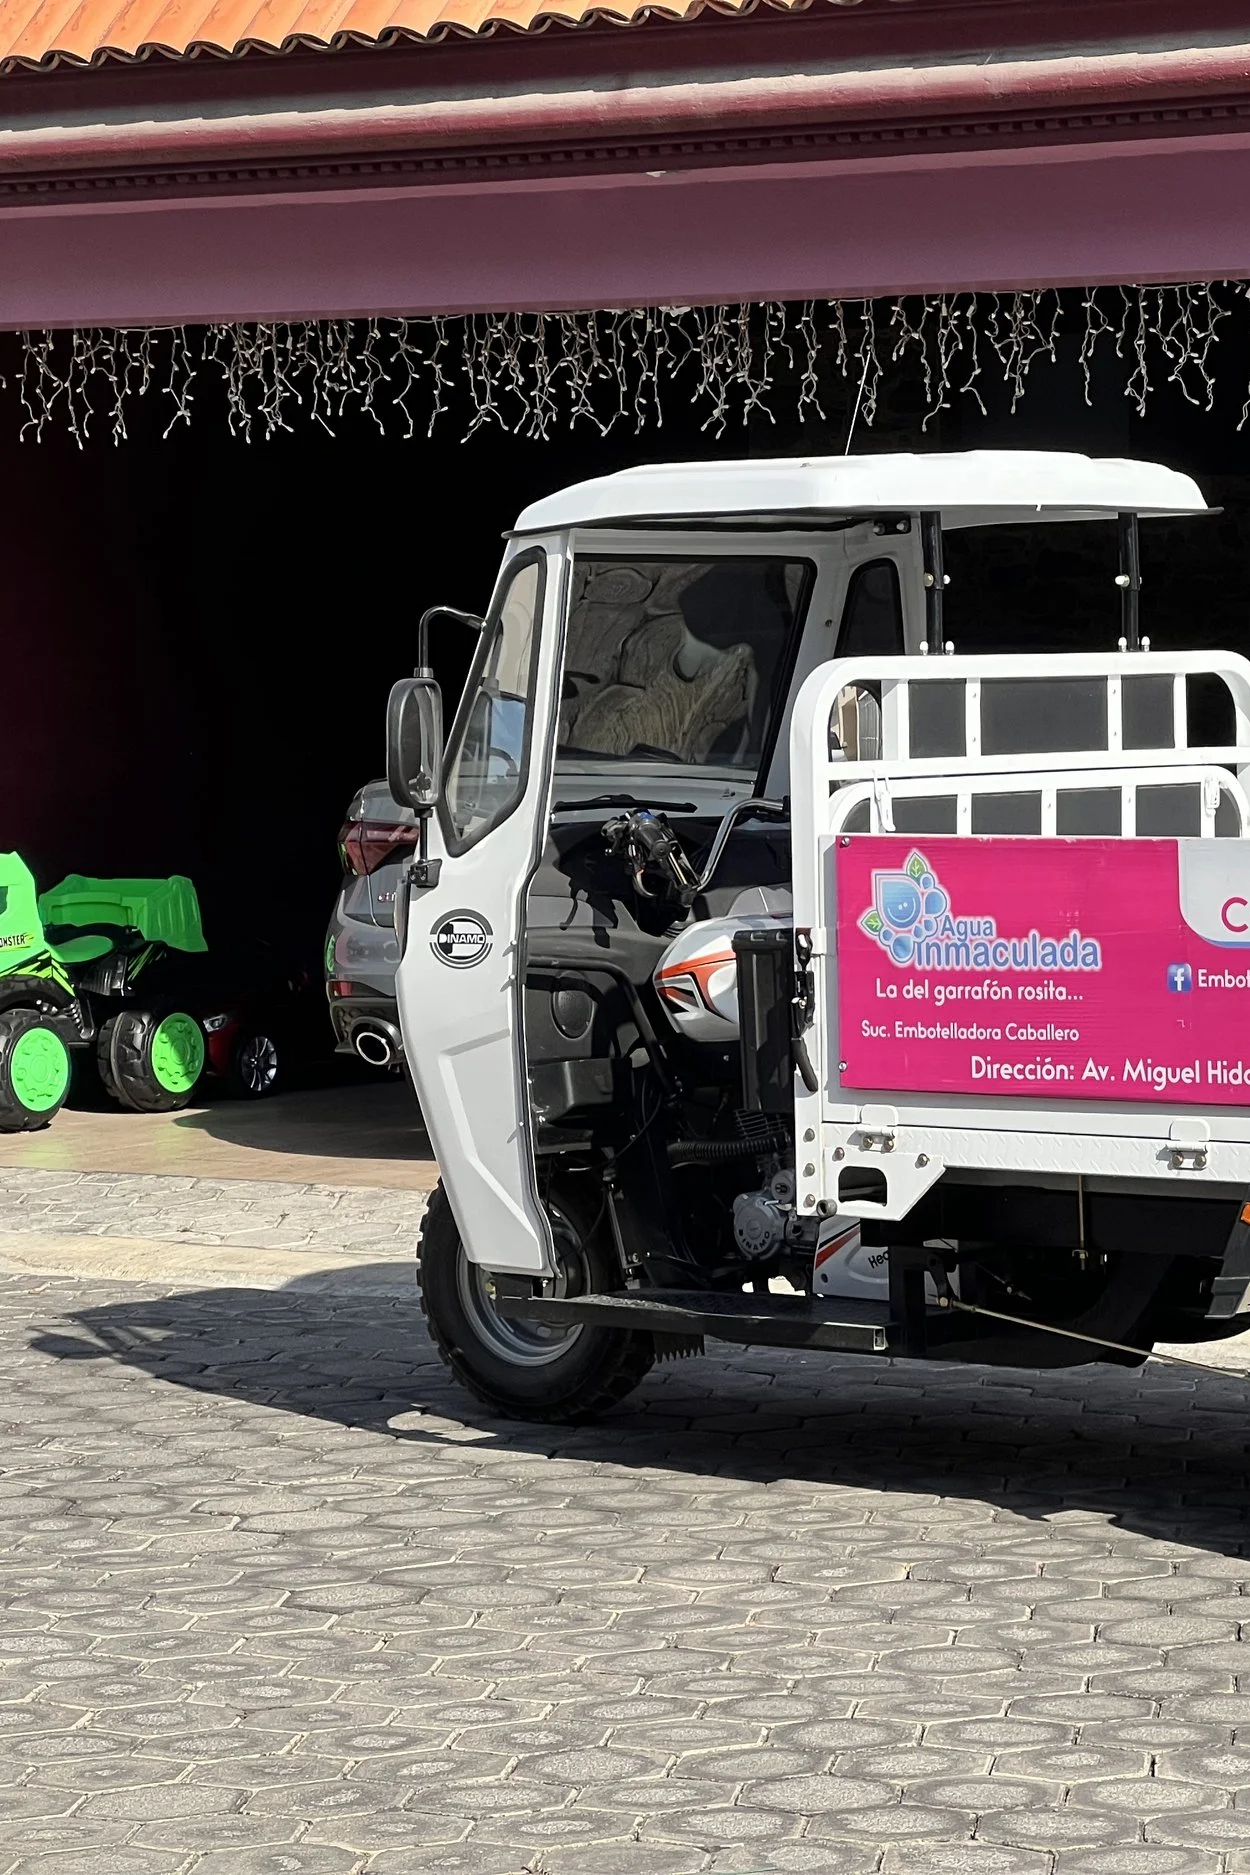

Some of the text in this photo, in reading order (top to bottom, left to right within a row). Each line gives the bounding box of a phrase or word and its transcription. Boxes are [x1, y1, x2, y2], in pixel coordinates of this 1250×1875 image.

[439, 934, 485, 943] DINAMO
[939, 915, 994, 940] Agua
[876, 979, 1084, 1006] La del garrafón rosita...
[861, 1020, 1080, 1042] Suc. Embotelladora Caballero
[971, 1056, 1074, 1080] Dirección:
[1082, 1058, 1115, 1082] Av.
[1123, 1059, 1200, 1091] Miguel
